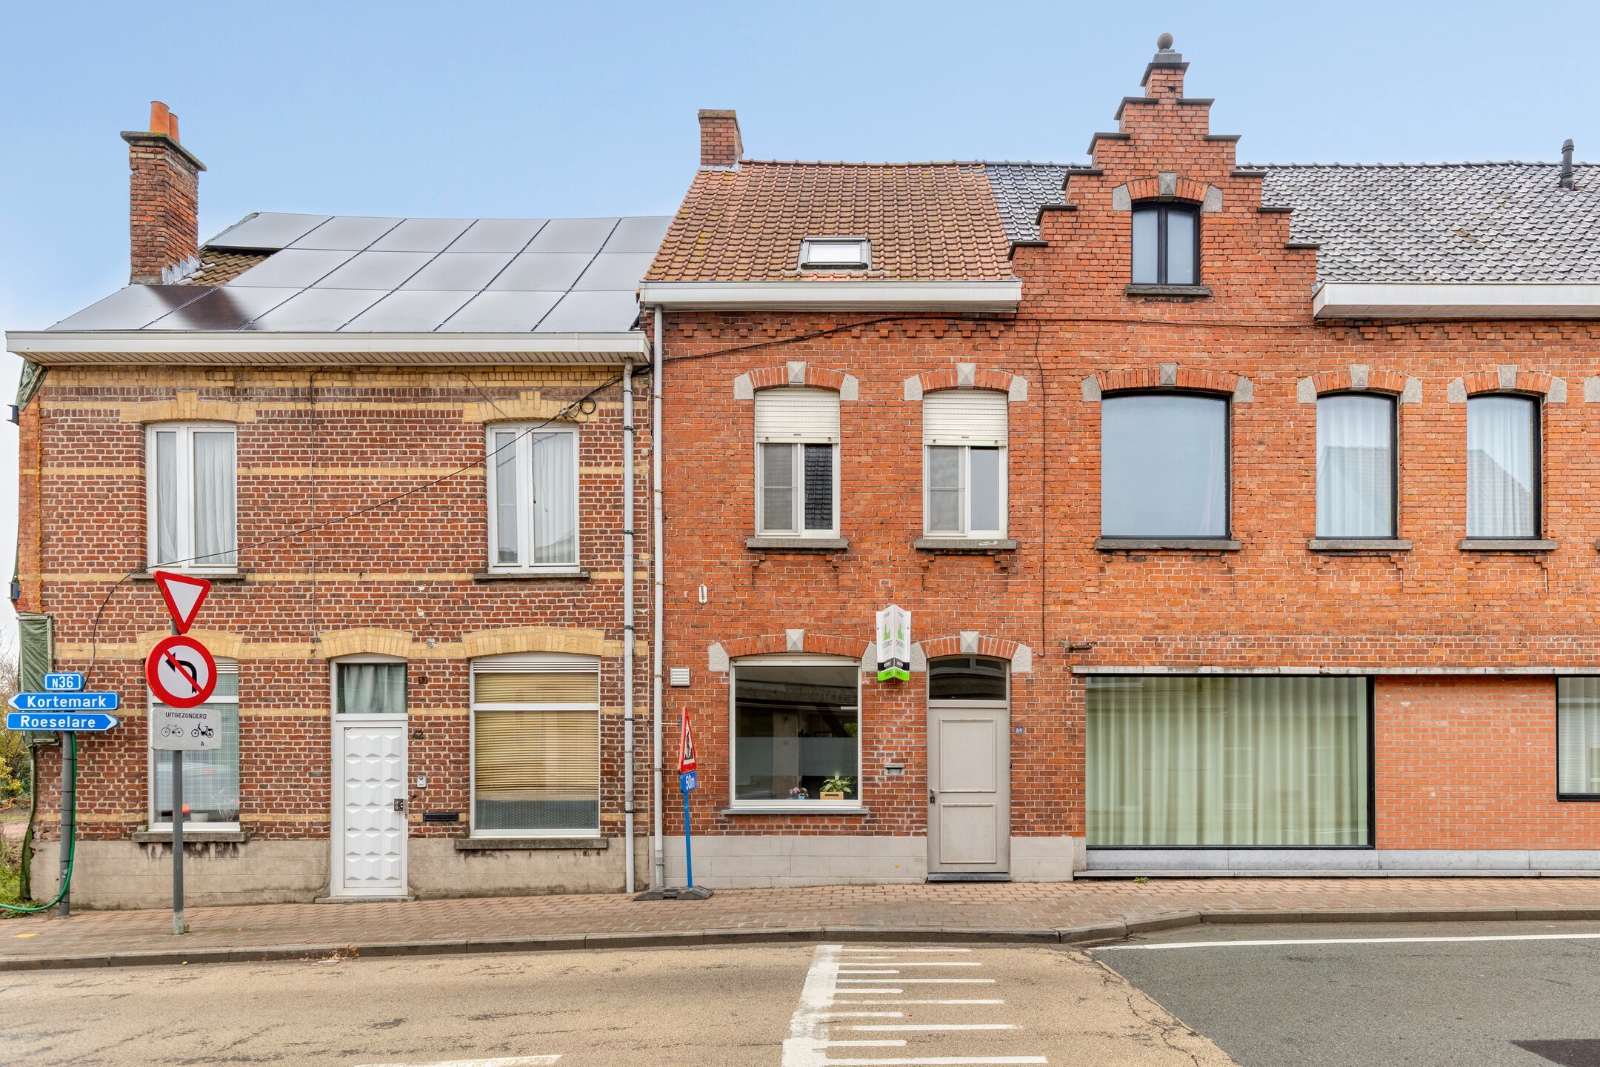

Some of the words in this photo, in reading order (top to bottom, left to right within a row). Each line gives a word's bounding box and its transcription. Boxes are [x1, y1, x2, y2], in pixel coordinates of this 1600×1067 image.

[52, 676, 74, 688] N36
[27, 695, 107, 708] Kortemark
[20, 715, 96, 728] Roeselare
[165, 711, 207, 720] UITGEZONDERD
[685, 774, 695, 791] 50m
